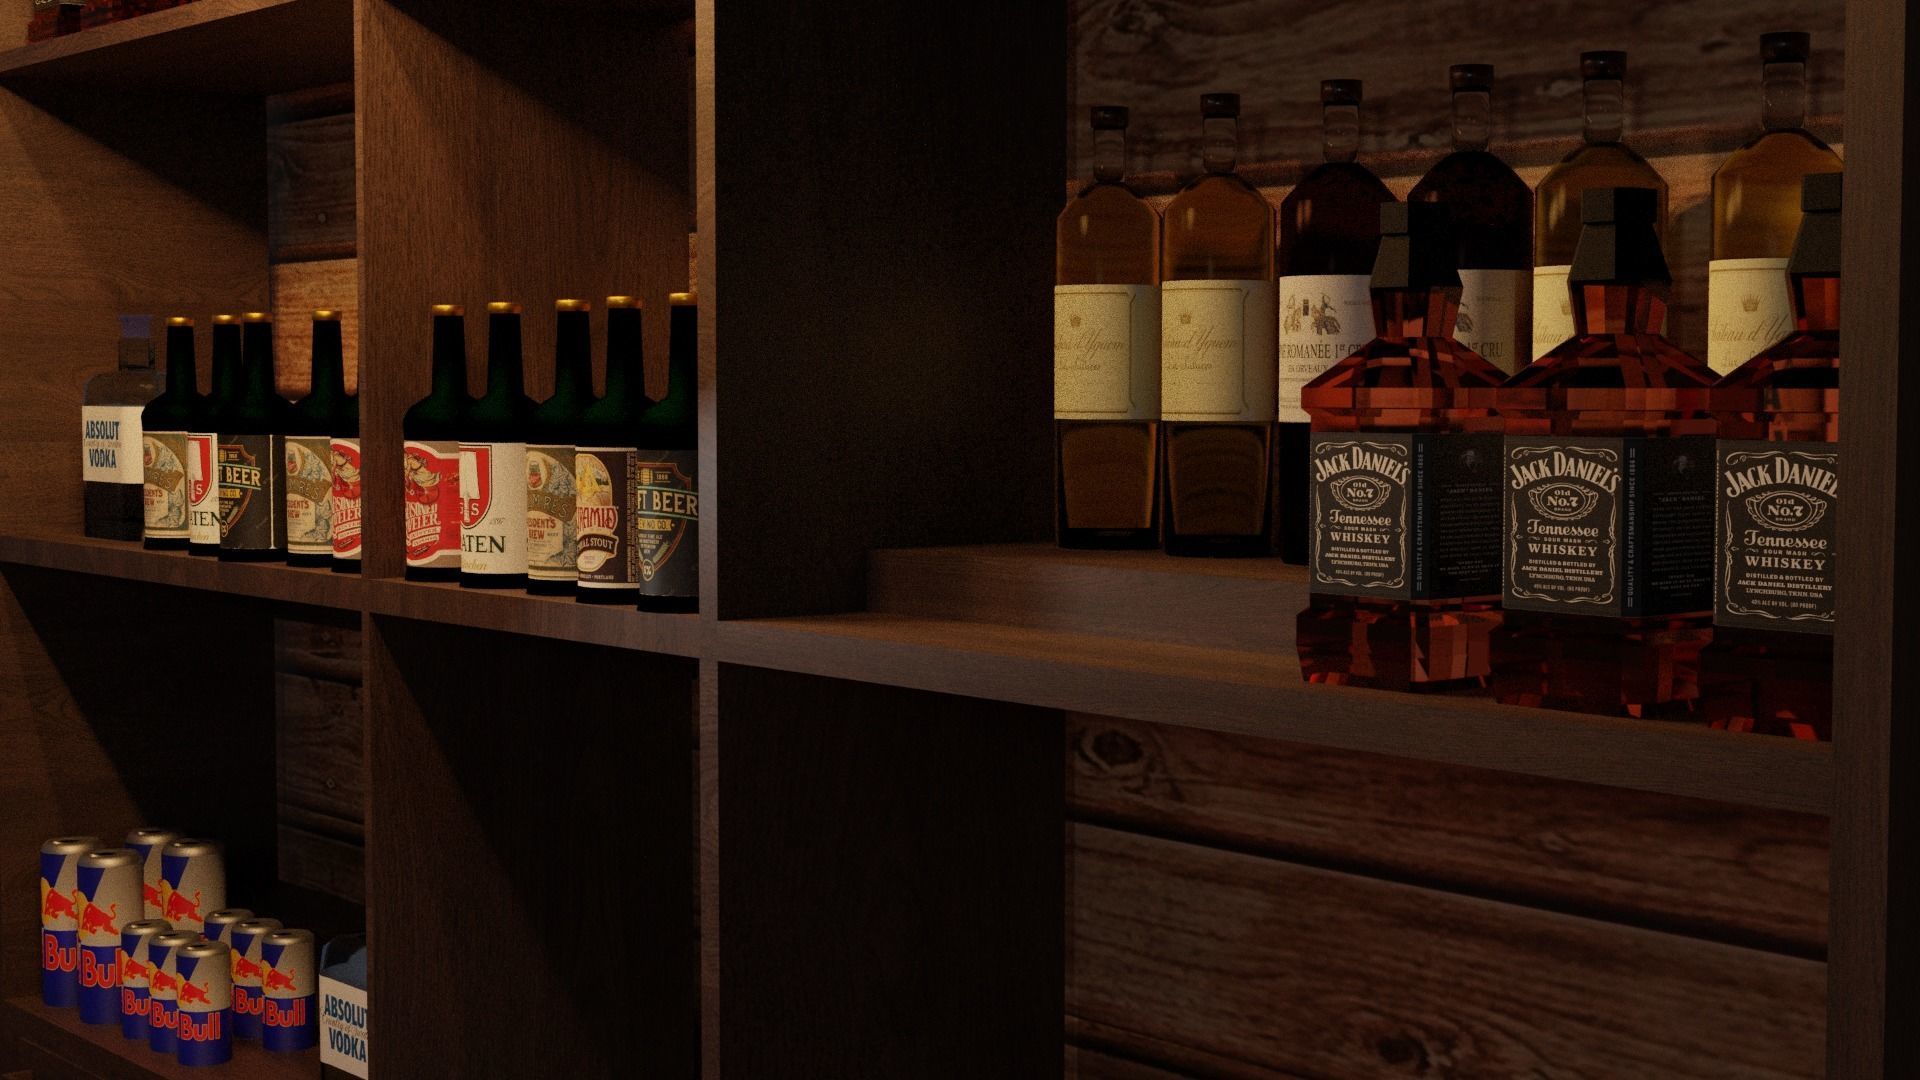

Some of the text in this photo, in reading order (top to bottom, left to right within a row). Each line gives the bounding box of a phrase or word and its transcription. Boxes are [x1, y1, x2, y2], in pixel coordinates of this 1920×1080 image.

[1481, 342, 1503, 358] CRU
[85, 421, 120, 440] ABSOLUT
[89, 448, 117, 468] VODKA
[1314, 446, 1411, 485] JACK DANIEL'S
[225, 467, 262, 487] BEER
[1510, 451, 1621, 493] JACK DANIEL'S
[1724, 456, 1838, 498] JACK DANIEL
[652, 491, 698, 517] BEER
[1767, 505, 1804, 517] No.7
[190, 511, 220, 526] TEN
[1329, 509, 1391, 526] Tennessee
[1330, 532, 1390, 544] WHISKEY
[1527, 519, 1599, 537] Tennessee
[461, 534, 506, 553] ATEN
[590, 537, 613, 550] STOUT
[1744, 529, 1827, 549] Tennessee
[1528, 543, 1598, 557] WHISKEY
[1744, 555, 1826, 570] WHISKEY
[1758, 580, 1786, 588] DANIEL
[1787, 582, 1832, 591] DISTILLERY
[44, 933, 77, 973] Bu
[82, 948, 122, 989] Bul
[124, 987, 149, 1016] Bu
[236, 988, 263, 1015] Bu
[152, 1001, 178, 1029] Bu
[266, 998, 306, 1028] Bull
[180, 1012, 221, 1042] Bull
[329, 1027, 367, 1063] VODKA
